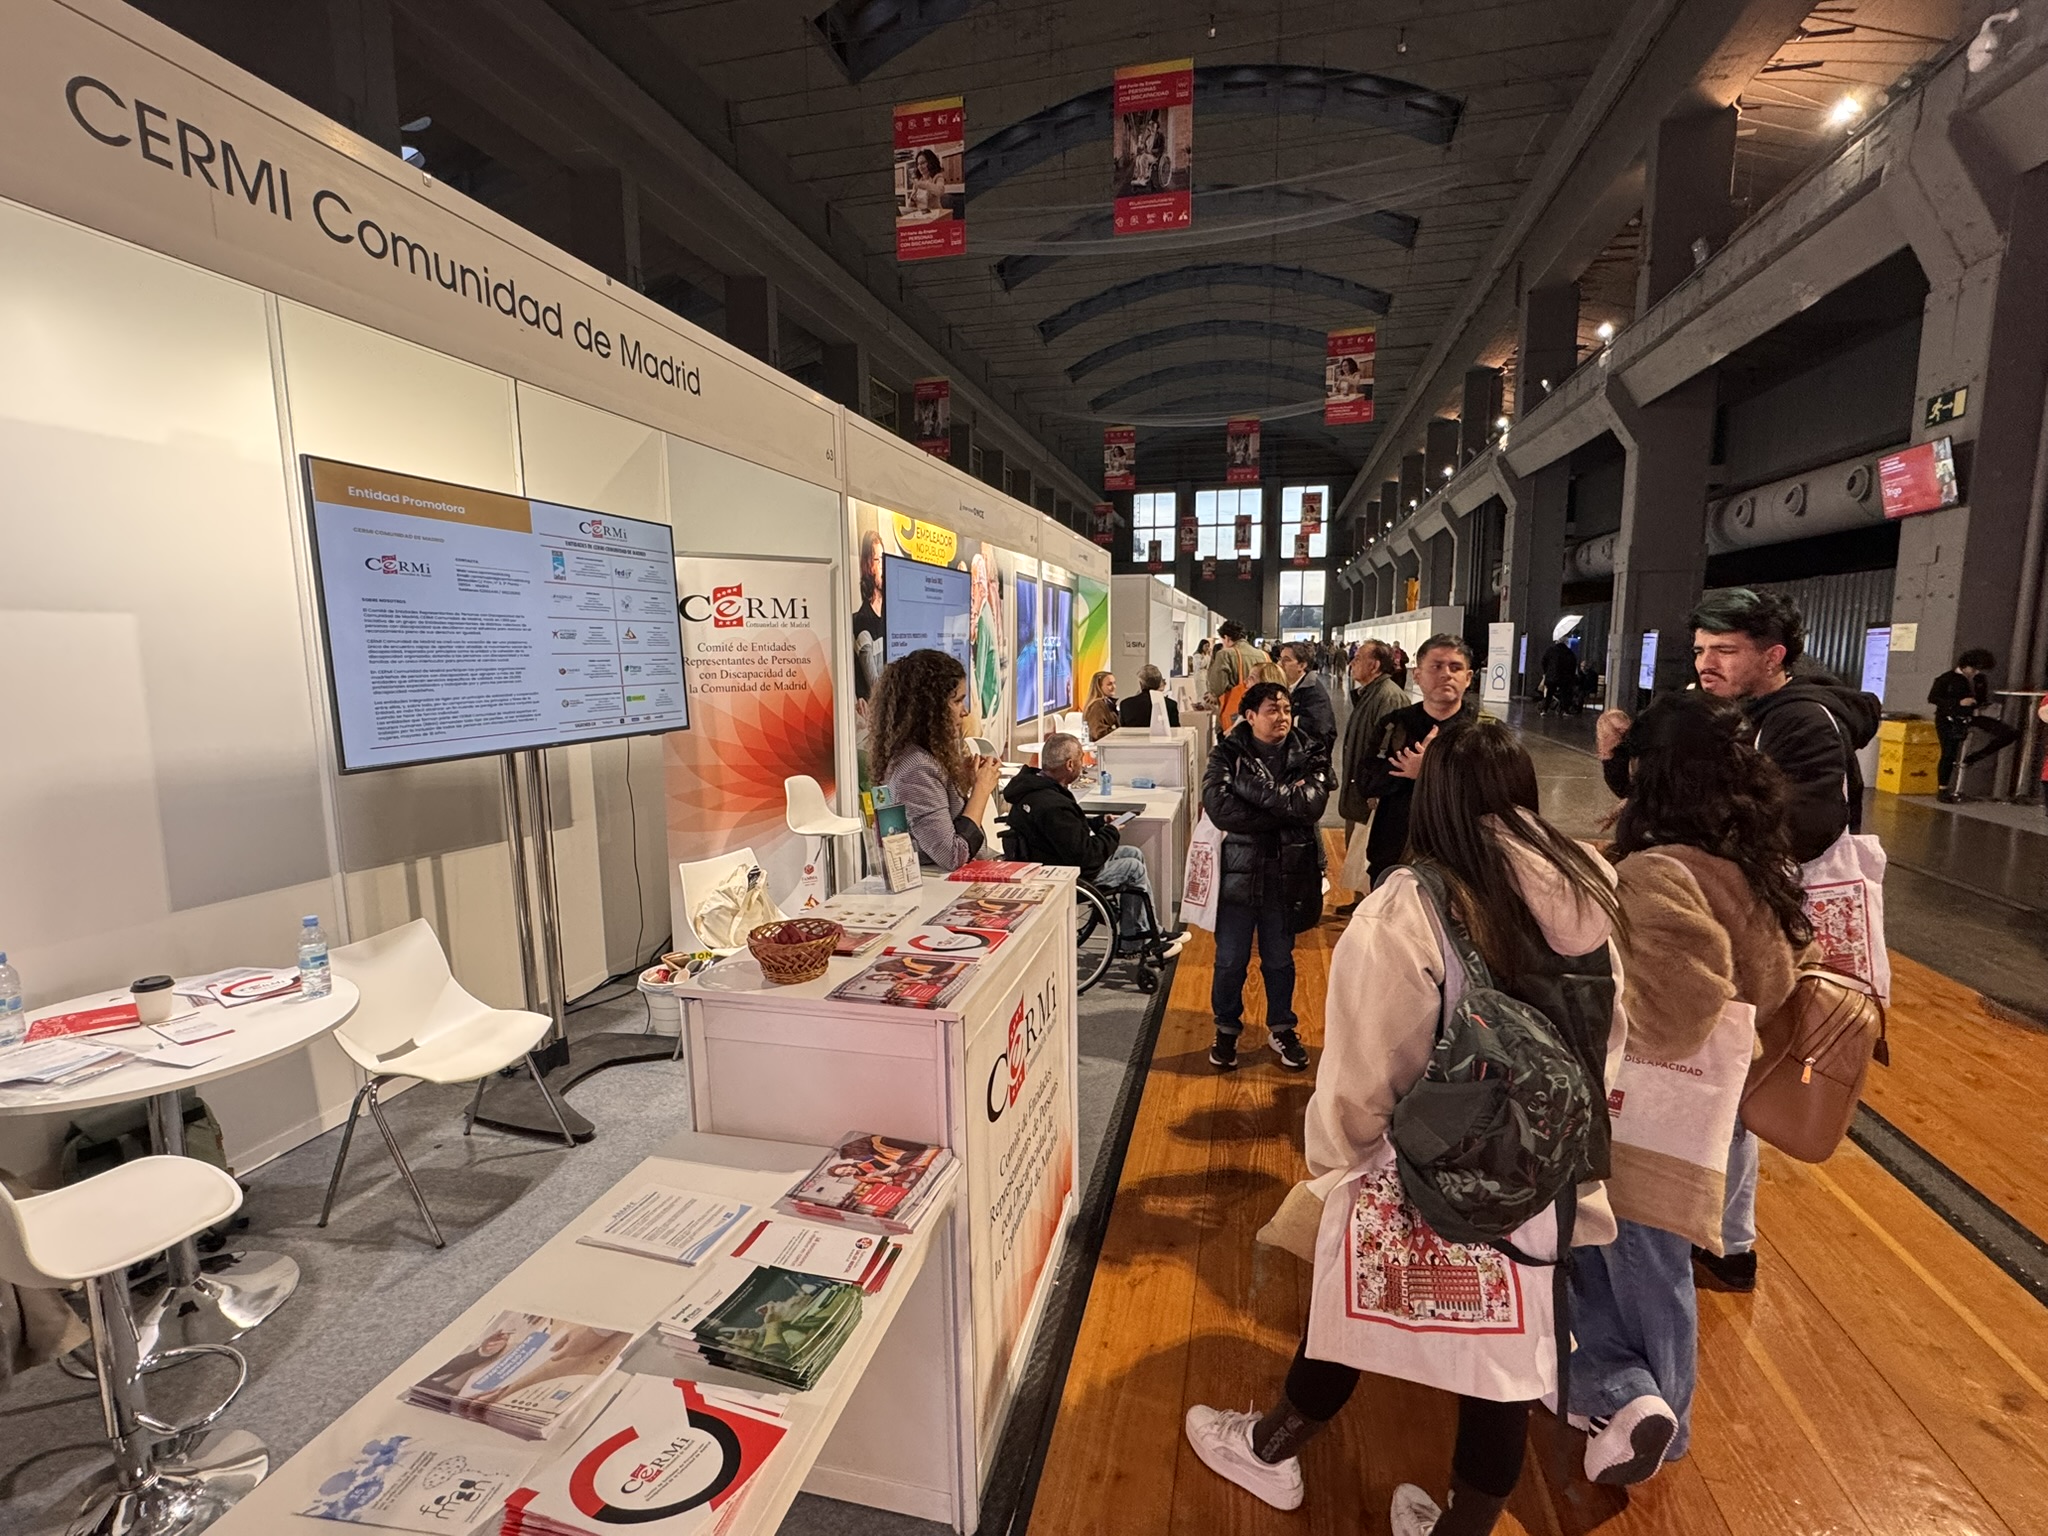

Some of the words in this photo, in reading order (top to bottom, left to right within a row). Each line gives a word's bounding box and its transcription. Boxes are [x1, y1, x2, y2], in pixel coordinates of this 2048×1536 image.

[1128, 86, 1157, 95] PERSONAS
[1131, 90, 1170, 100] DISCAPACIDAD
[64, 75, 293, 222] CERMI
[312, 189, 564, 341] Comunidad
[573, 317, 612, 359] de
[620, 332, 702, 397] Madrid
[911, 238, 945, 247] DISCAPACIDAD
[826, 448, 834, 462] 63
[348, 486, 400, 504] Entidad
[402, 496, 466, 515] Promotora
[374, 529, 414, 541] COMUNIDAD
[422, 535, 445, 543] MADRID
[579, 519, 628, 539] CERMi
[916, 526, 953, 548] EMPLEADOR
[916, 542, 925, 554] NO
[364, 555, 432, 575] CERMi
[746, 621, 779, 629] Comunidad
[790, 621, 811, 629] Madrid
[697, 642, 734, 653] Comité
[736, 642, 749, 653] de
[751, 642, 797, 652] Entidades
[684, 656, 756, 669] Representantes
[758, 655, 769, 665] de
[771, 655, 811, 665] Personas
[698, 671, 717, 680] con
[720, 668, 784, 681] Discapacidad
[785, 668, 797, 678] de
[689, 684, 698, 694] la
[700, 682, 758, 693] Comunidad
[760, 682, 771, 692] de
[773, 681, 807, 691] Madrid
[1000, 1122, 1021, 1177] Comité
[1021, 1113, 1028, 1133] de
[1028, 1067, 1052, 1118] Entidades
[990, 1132, 1032, 1228] Representantes
[1032, 1118, 1039, 1137] de
[1039, 1078, 1059, 1123] Personas
[1013, 1123, 1048, 1207] Discapacidad
[994, 1259, 1002, 1281] la
[1002, 1177, 1034, 1261] Comunidad
[620, 1437, 692, 1494] CERMi
